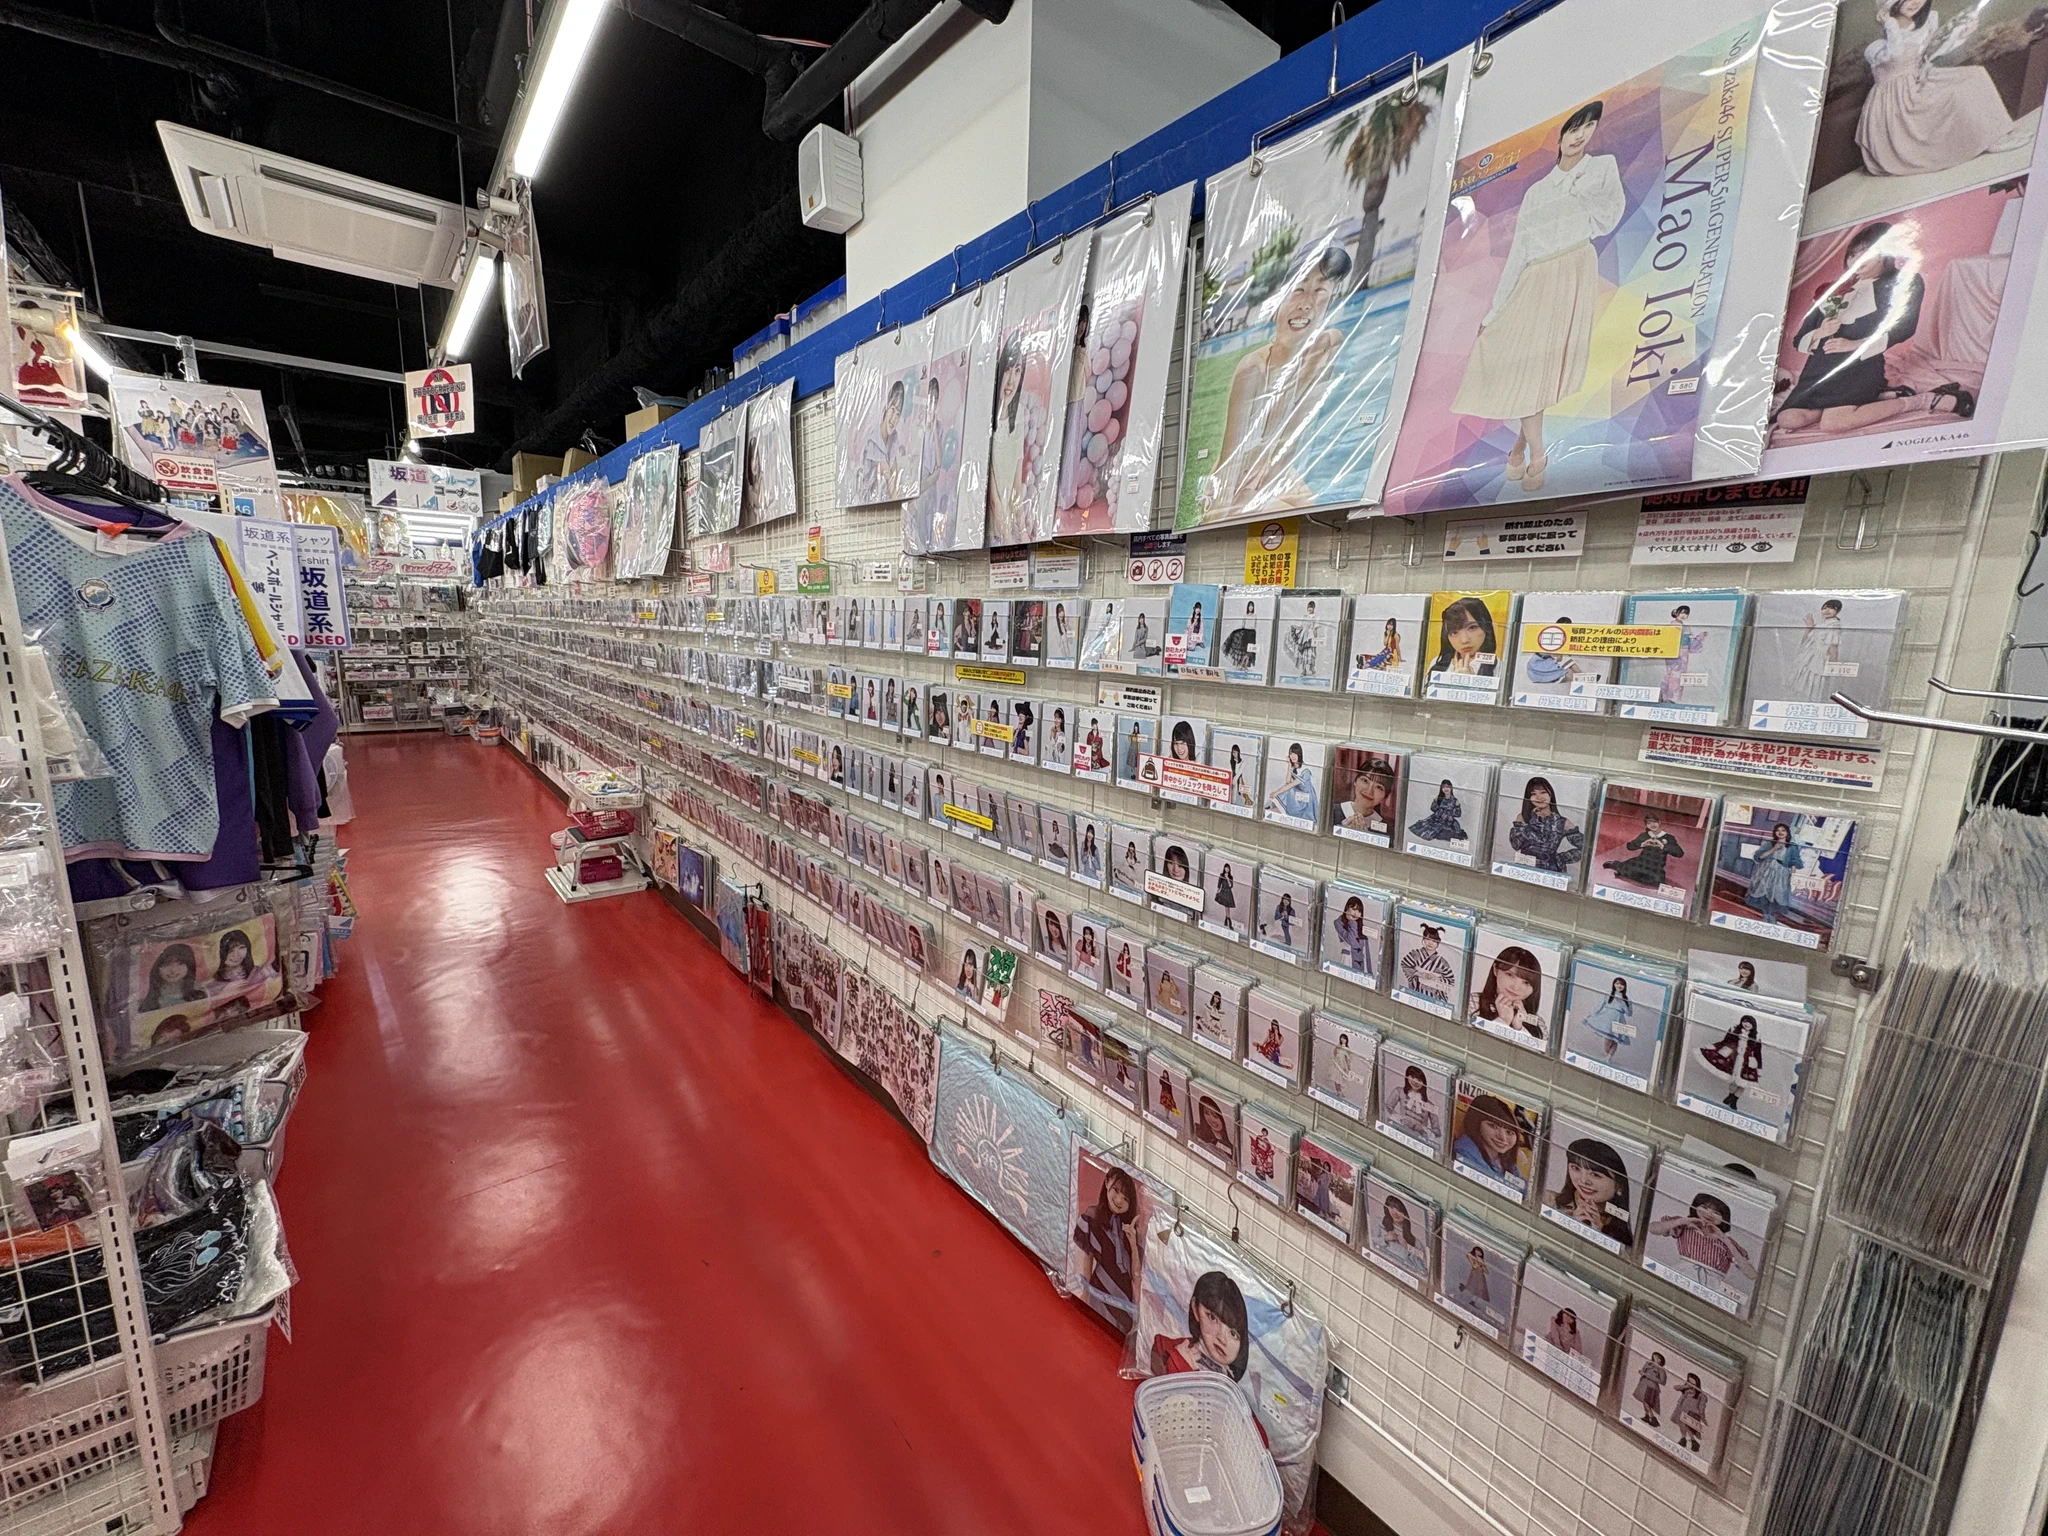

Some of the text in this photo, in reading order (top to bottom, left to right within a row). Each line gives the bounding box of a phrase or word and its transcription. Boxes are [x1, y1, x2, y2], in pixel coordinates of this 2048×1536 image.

[1717, 30, 1750, 125] Nogzaka46
[1715, 125, 1733, 182] SUPER
[1626, 134, 1716, 387] Mao Ioki
[1689, 211, 1725, 319] GENERATION
[433, 372, 443, 382] NO
[413, 381, 466, 398] PHOTOGRAPHING
[1896, 433, 1970, 447] NOGIZAKA46
[181, 465, 214, 477] 飲食物
[434, 485, 479, 498] コーナー
[1504, 517, 1574, 530] 折れ防止のため
[244, 527, 290, 544] 坂道系
[298, 535, 330, 546] シャツ
[1499, 529, 1577, 542] 写真は手に取って
[1506, 543, 1565, 554] ご覧ください
[1648, 543, 1718, 553] すべて見えてます!!
[300, 567, 333, 633] 坂道系
[1571, 627, 1661, 636] 写真ファイルの店内閲覧は
[305, 635, 345, 645] USED
[1570, 635, 1637, 644] 防犯上の理由により
[1568, 643, 1664, 654] 禁止とさせて頂いています。
[1596, 686, 1620, 698] 丹生
[1538, 696, 1561, 707] 丹生
[1648, 708, 1707, 724] 丹生 明里
[1786, 703, 1819, 717] 丹生
[1784, 719, 1856, 736] 丹生 明里
[1649, 731, 1877, 765] 当店にて価格シールを貼り替え会計する、
[1647, 741, 1819, 770] 重大な詐欺行為が発覚しました。
[1163, 774, 1227, 796] 背中からリュックを降ろして
[1734, 917, 1780, 940] 佐々木
